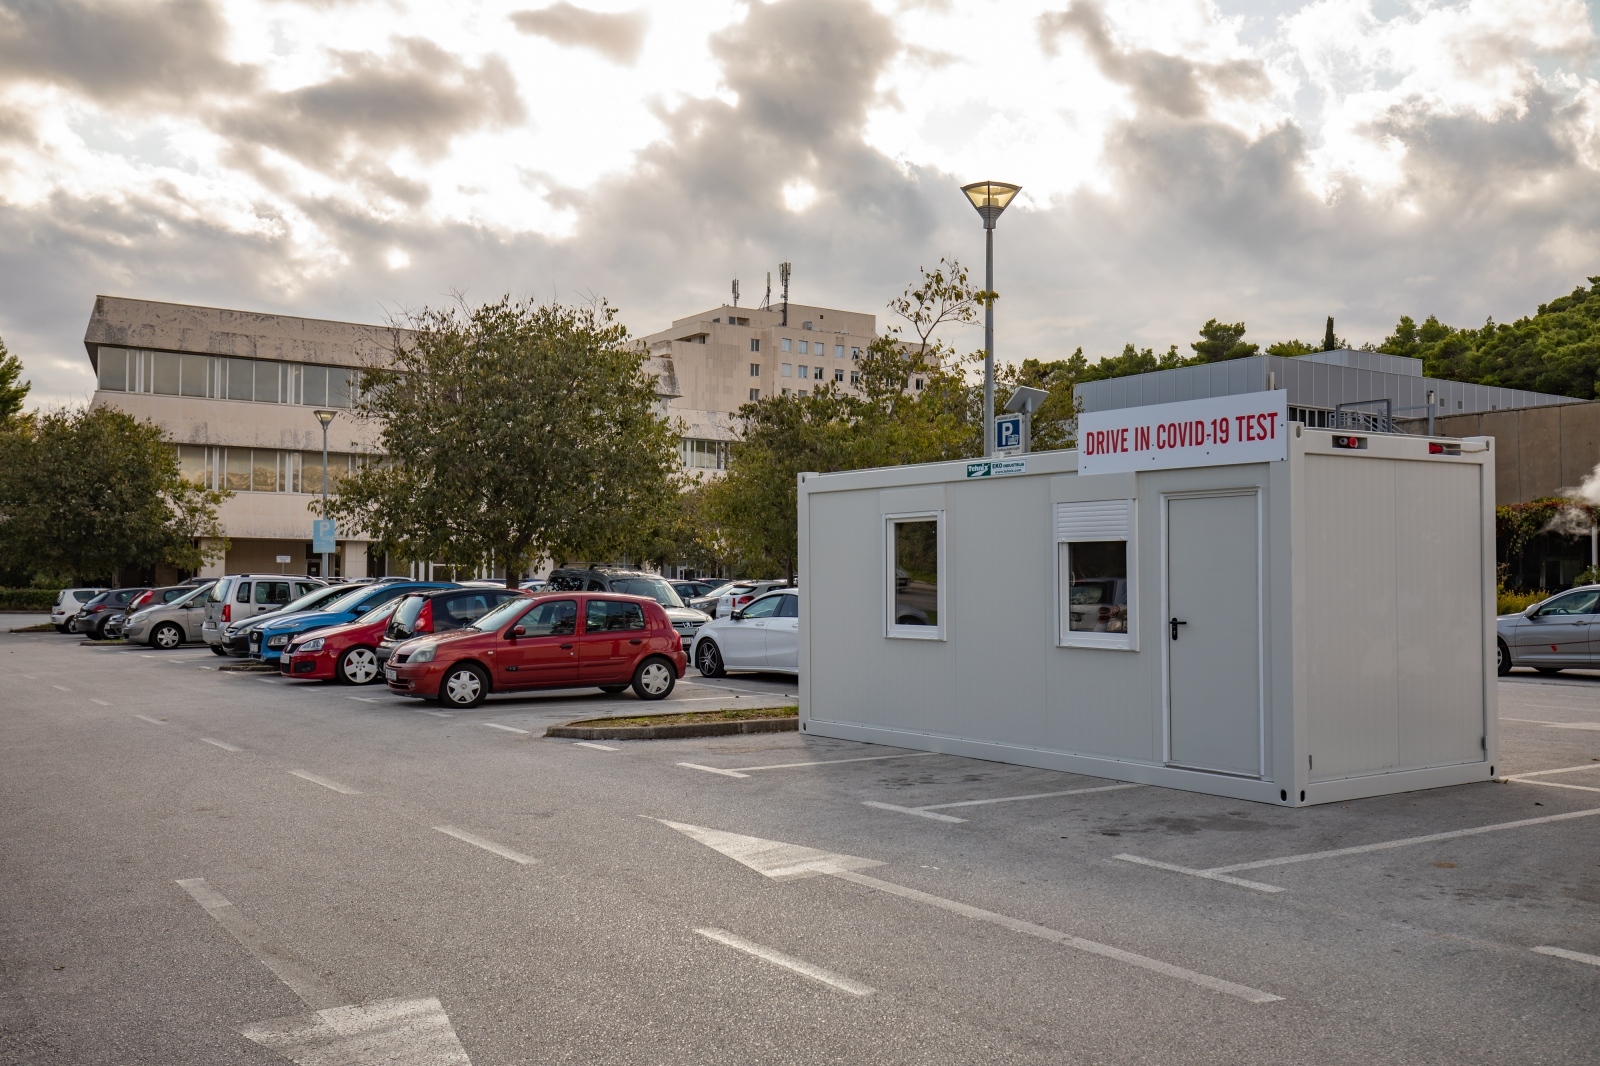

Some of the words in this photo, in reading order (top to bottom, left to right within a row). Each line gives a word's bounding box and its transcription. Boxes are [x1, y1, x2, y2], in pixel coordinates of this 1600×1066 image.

[1001, 422, 1013, 446] P
[1086, 428, 1129, 456] DRIVE
[1134, 425, 1150, 452] IN
[1156, 416, 1230, 450] COVID-19
[1235, 412, 1278, 442] TEST
[319, 521, 330, 537] P
